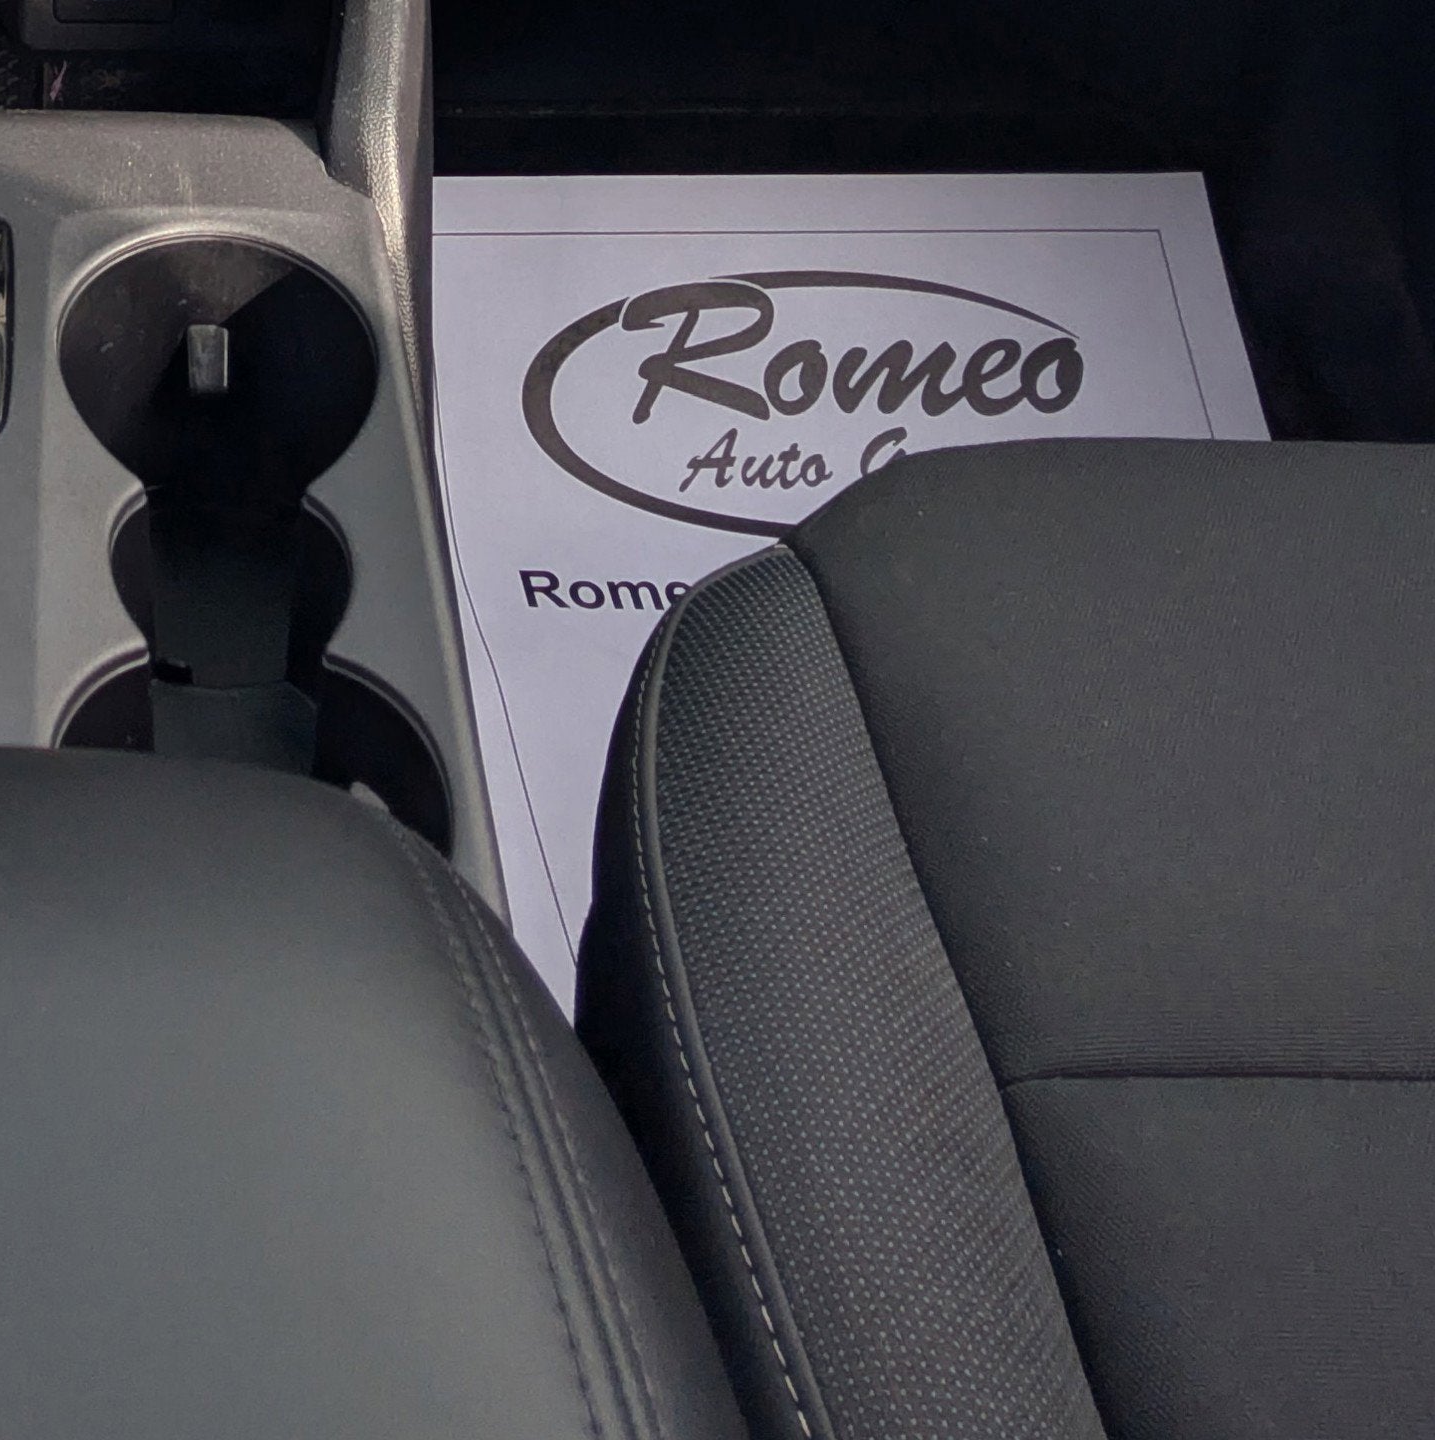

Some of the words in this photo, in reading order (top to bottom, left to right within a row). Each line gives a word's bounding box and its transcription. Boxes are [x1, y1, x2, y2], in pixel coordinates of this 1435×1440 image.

[621, 281, 1085, 426] Romeo
[678, 426, 833, 493] Auto
[518, 568, 688, 612] Rome
